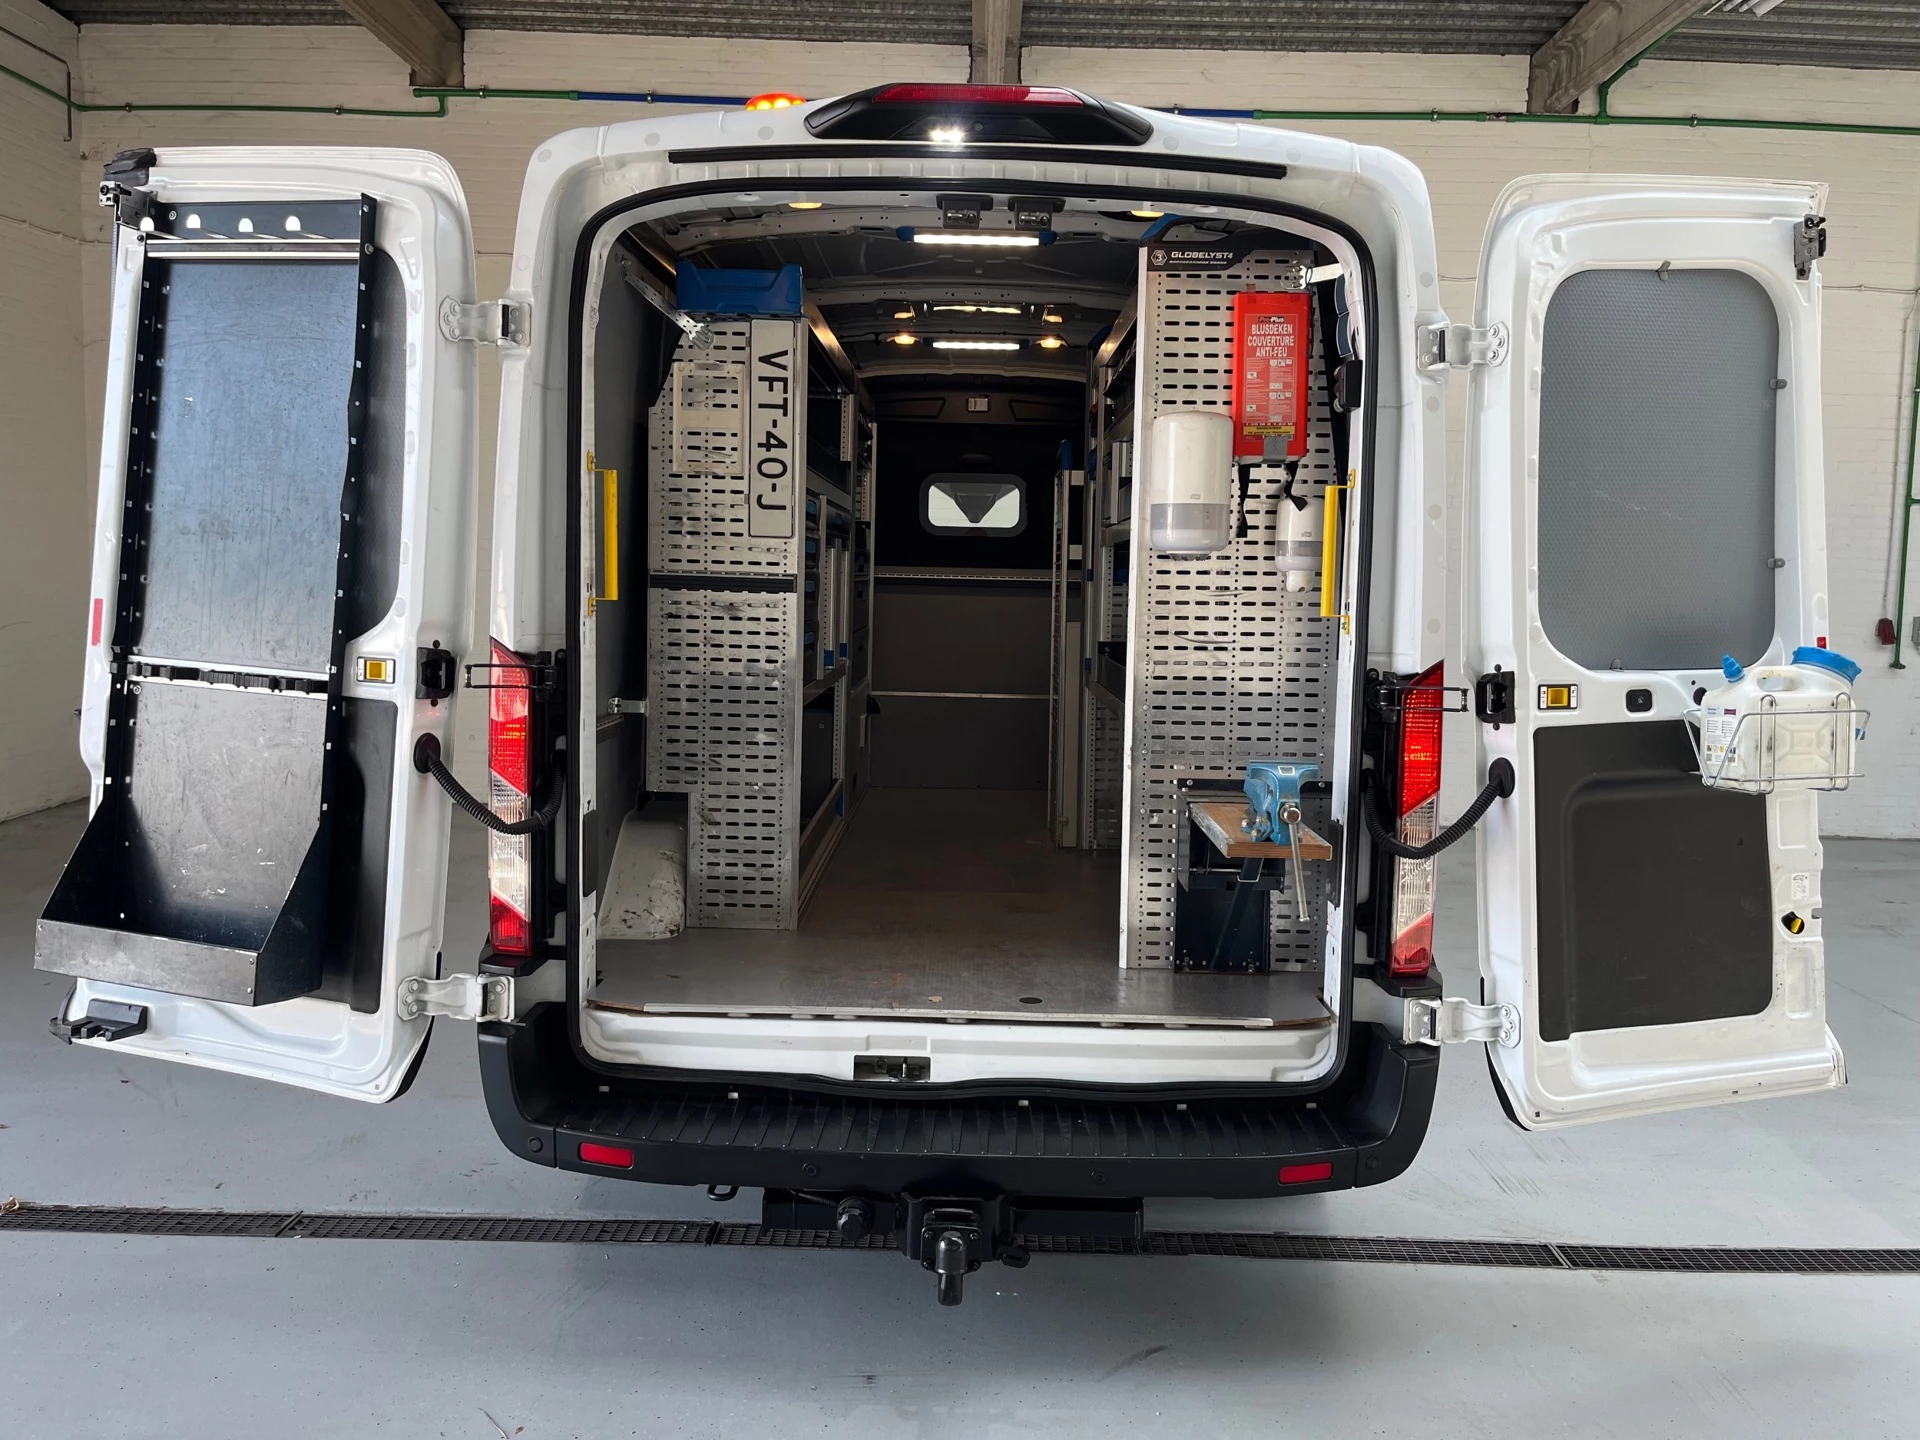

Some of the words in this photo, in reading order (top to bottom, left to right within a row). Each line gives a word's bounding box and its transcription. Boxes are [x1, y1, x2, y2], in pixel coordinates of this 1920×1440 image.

[1171, 251, 1233, 259] GLOBELYST4
[1251, 323, 1293, 335] BLUSDEKEN
[1247, 335, 1295, 347] COUVERTURE
[1255, 346, 1288, 358] ANTI-FEU
[756, 349, 789, 511] VFT-40-J
